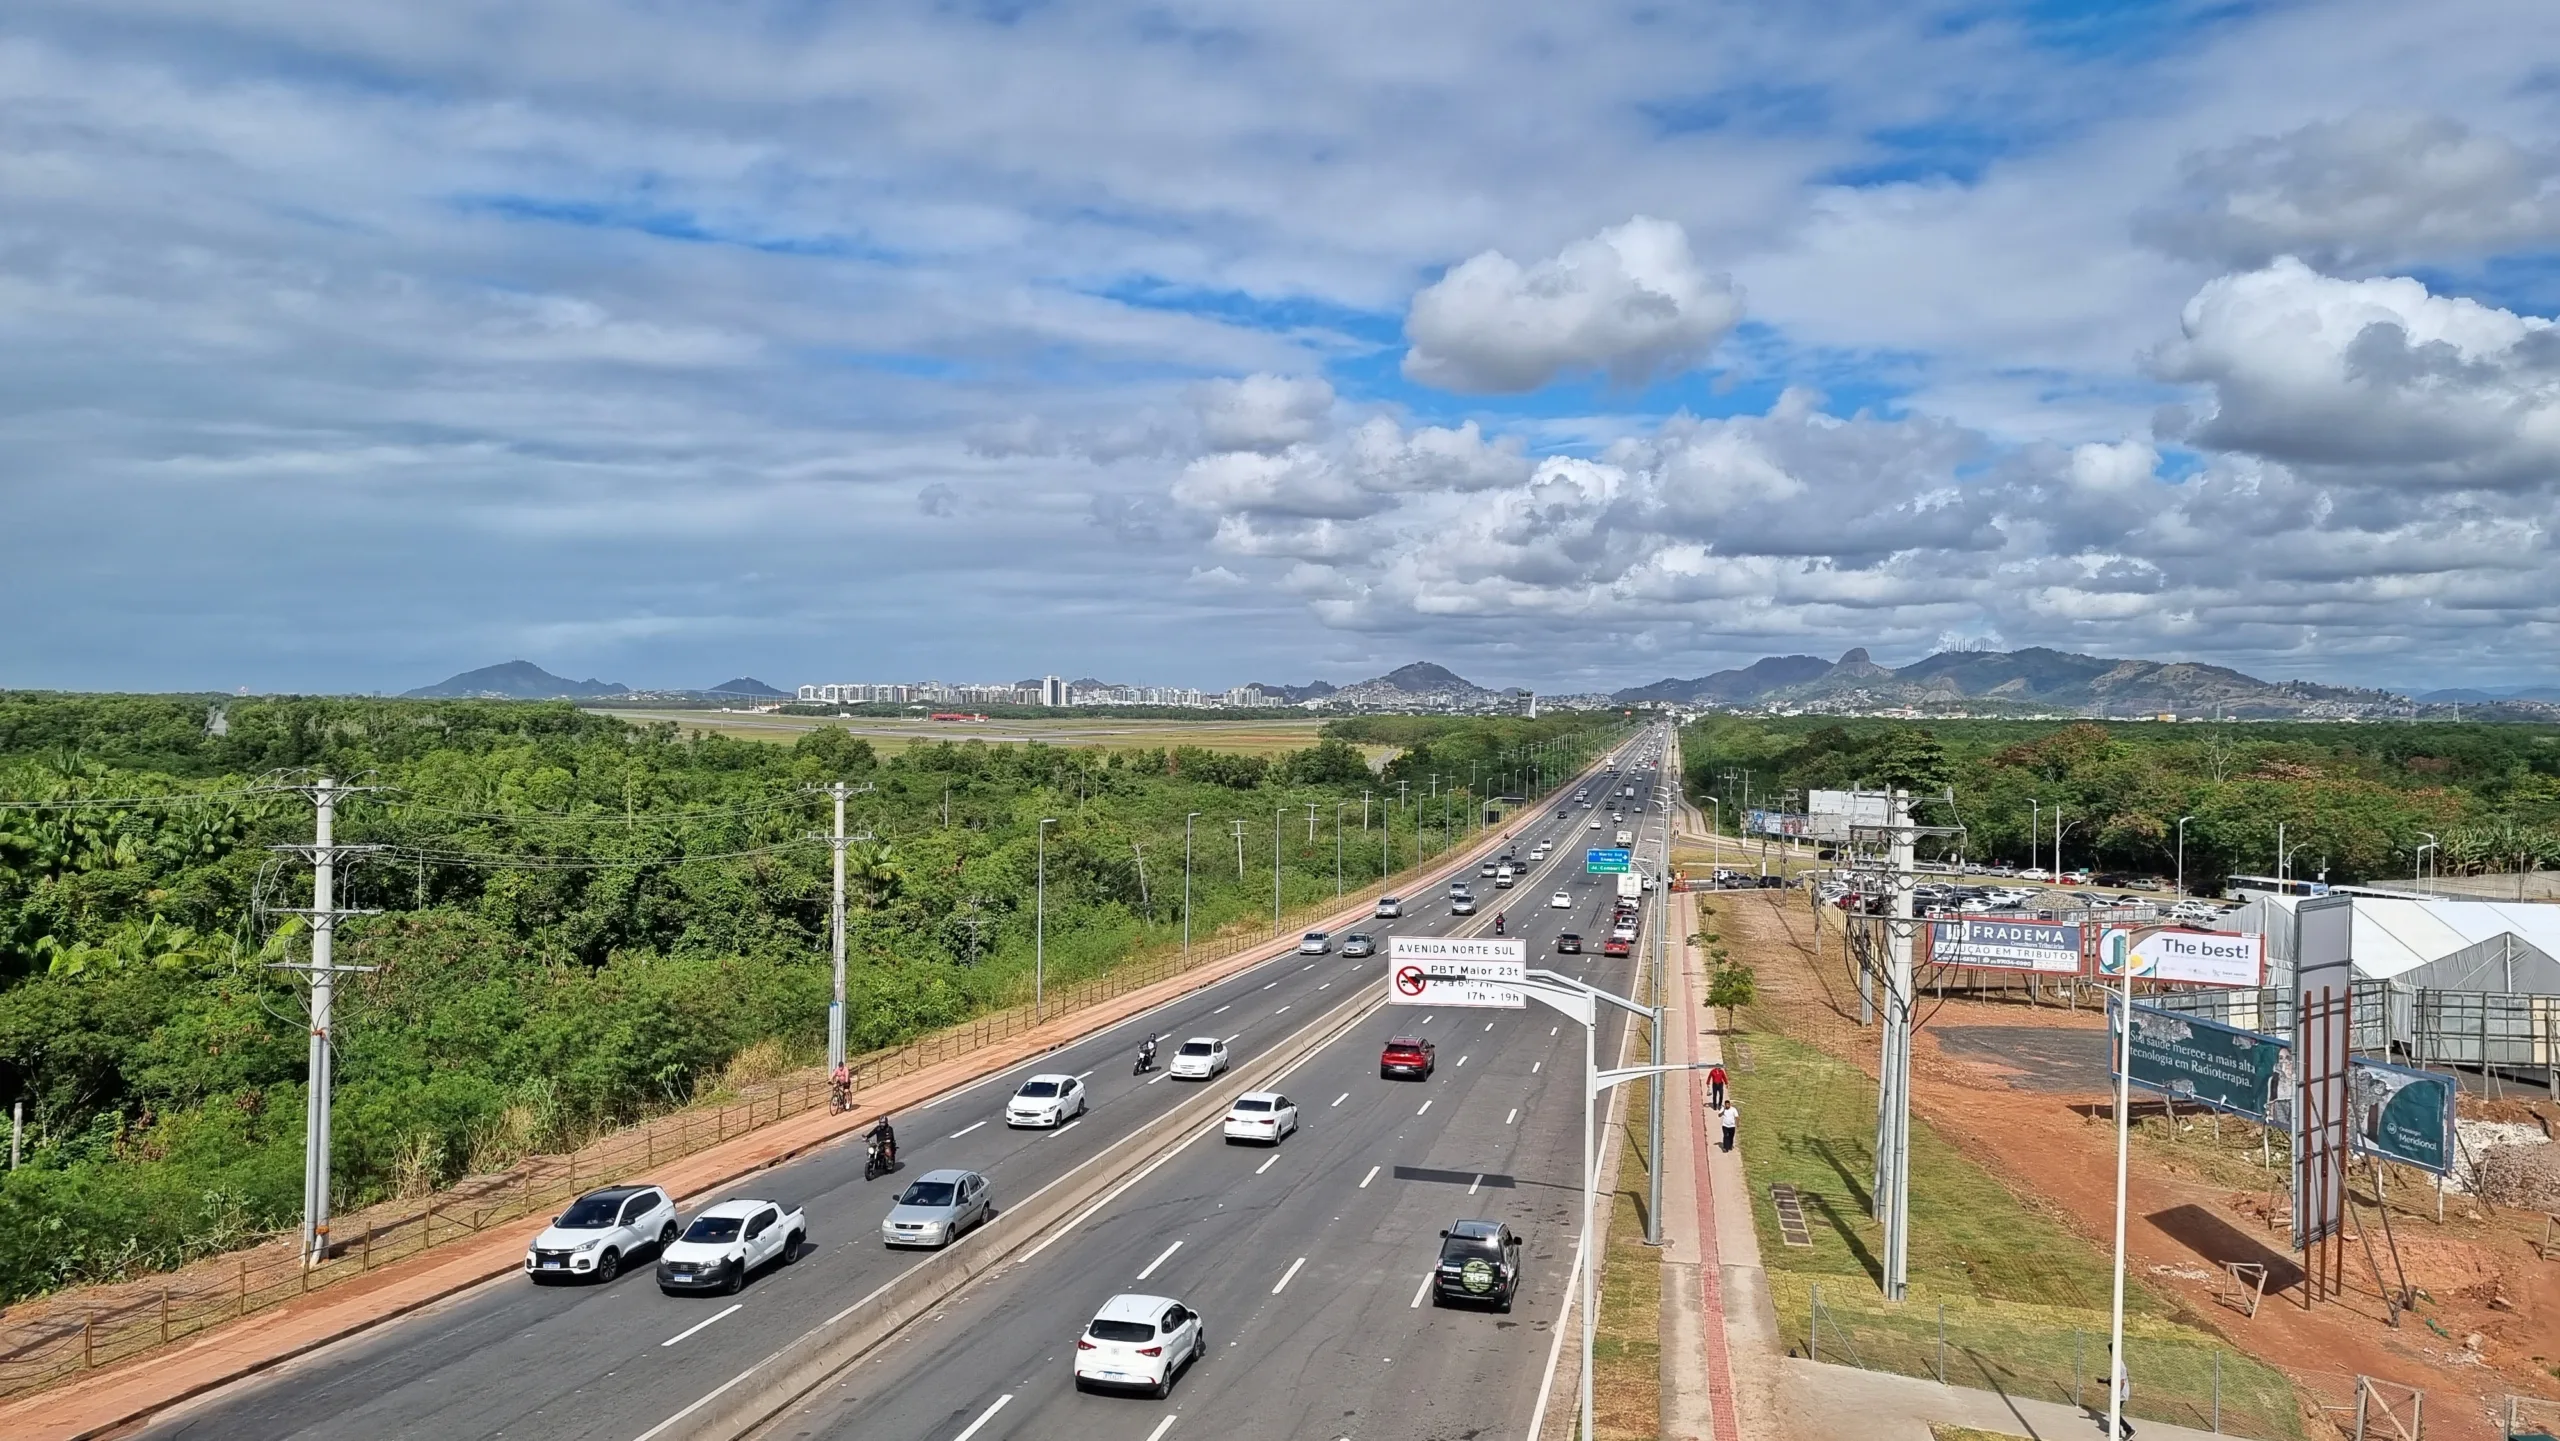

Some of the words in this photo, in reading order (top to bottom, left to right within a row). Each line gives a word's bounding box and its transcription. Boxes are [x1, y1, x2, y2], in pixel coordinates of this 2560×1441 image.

[1973, 926, 2064, 943] FRADEMA
[1398, 944, 1446, 954] AVENIDA
[1452, 945, 1488, 955] NORTE
[1494, 946, 1515, 956] SUL
[1996, 946, 2011, 956] EM
[2018, 948, 2075, 960] TRIBUTOS
[2162, 938, 2196, 954] The
[2202, 942, 2249, 960] best!
[1431, 965, 1455, 974] PBT
[1460, 966, 1492, 975] Maior
[1499, 967, 1518, 976] 23t
[1468, 992, 1486, 1000] 17h
[1500, 992, 1519, 1002] 19h
[2130, 1046, 2173, 1066] tecnologia
[2174, 1059, 2188, 1070] em
[2192, 1060, 2252, 1088] Radioterapia.
[2173, 1044, 2206, 1060] merece
[2208, 1053, 2213, 1062] a
[2216, 1055, 2237, 1069] mais
[2238, 1060, 2256, 1074] alta
[2399, 1133, 2437, 1150] Meridional
